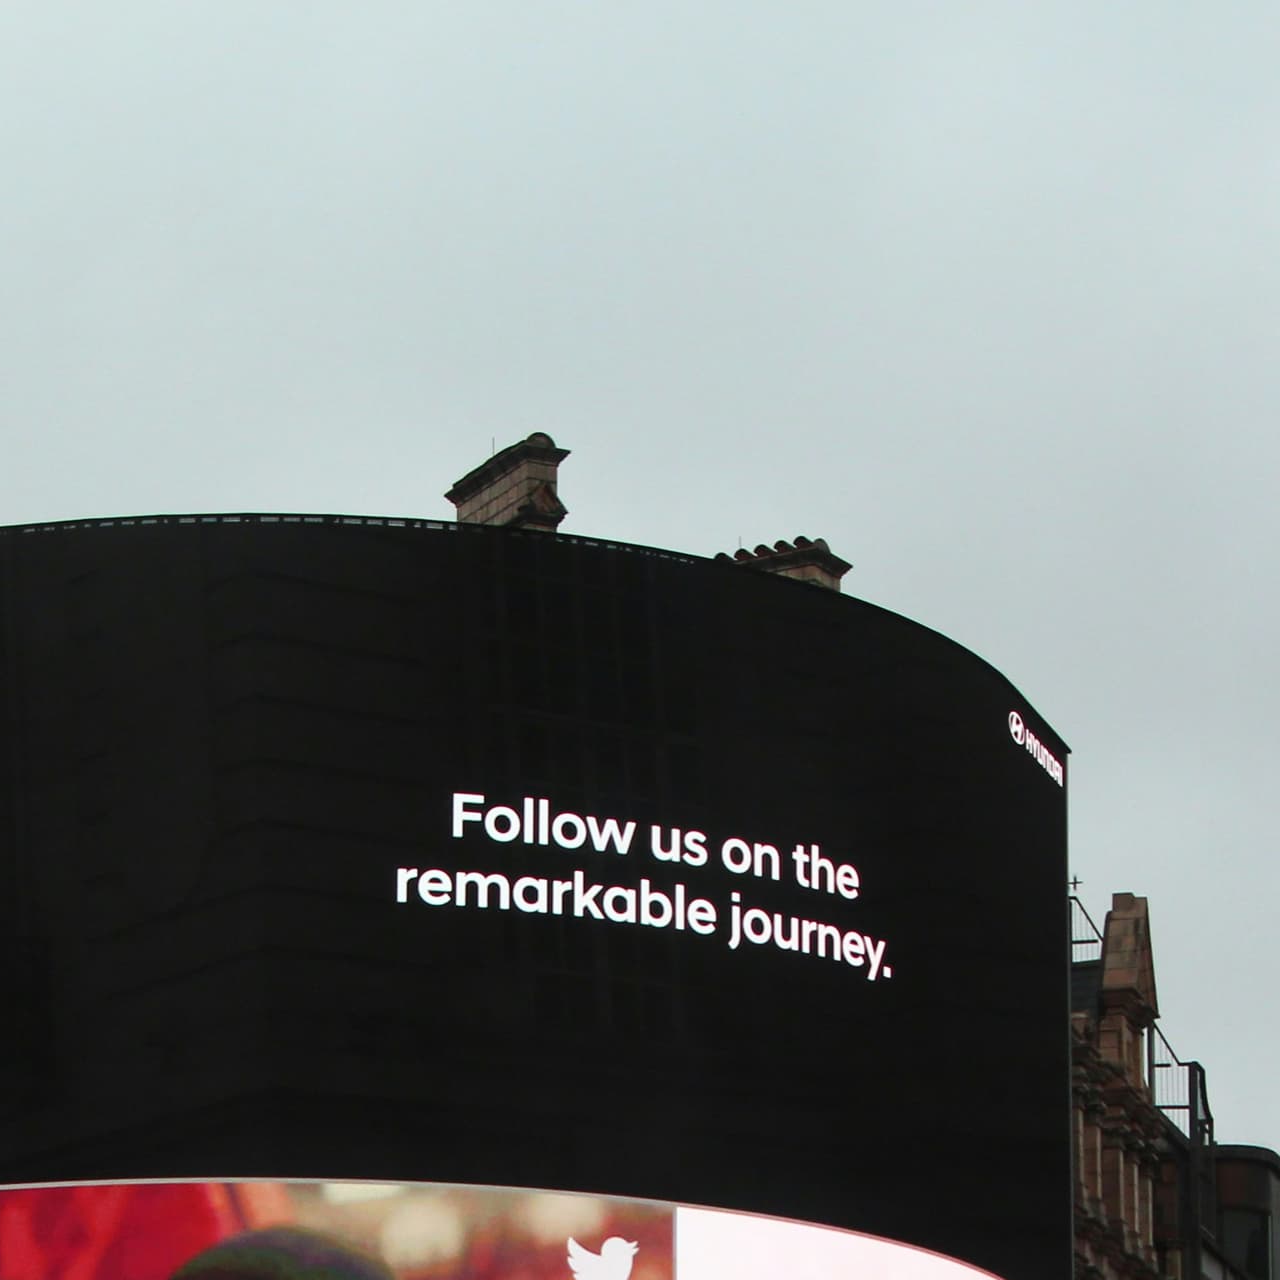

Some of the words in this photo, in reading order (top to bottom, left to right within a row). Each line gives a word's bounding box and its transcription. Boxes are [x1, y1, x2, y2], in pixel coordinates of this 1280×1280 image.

[1025, 728, 1063, 787] HYUNDAI
[452, 793, 636, 856] Follow
[650, 824, 709, 868] us
[721, 836, 781, 882] on
[792, 842, 860, 901] the
[396, 863, 718, 936] remarkable
[728, 892, 893, 982] journey.
